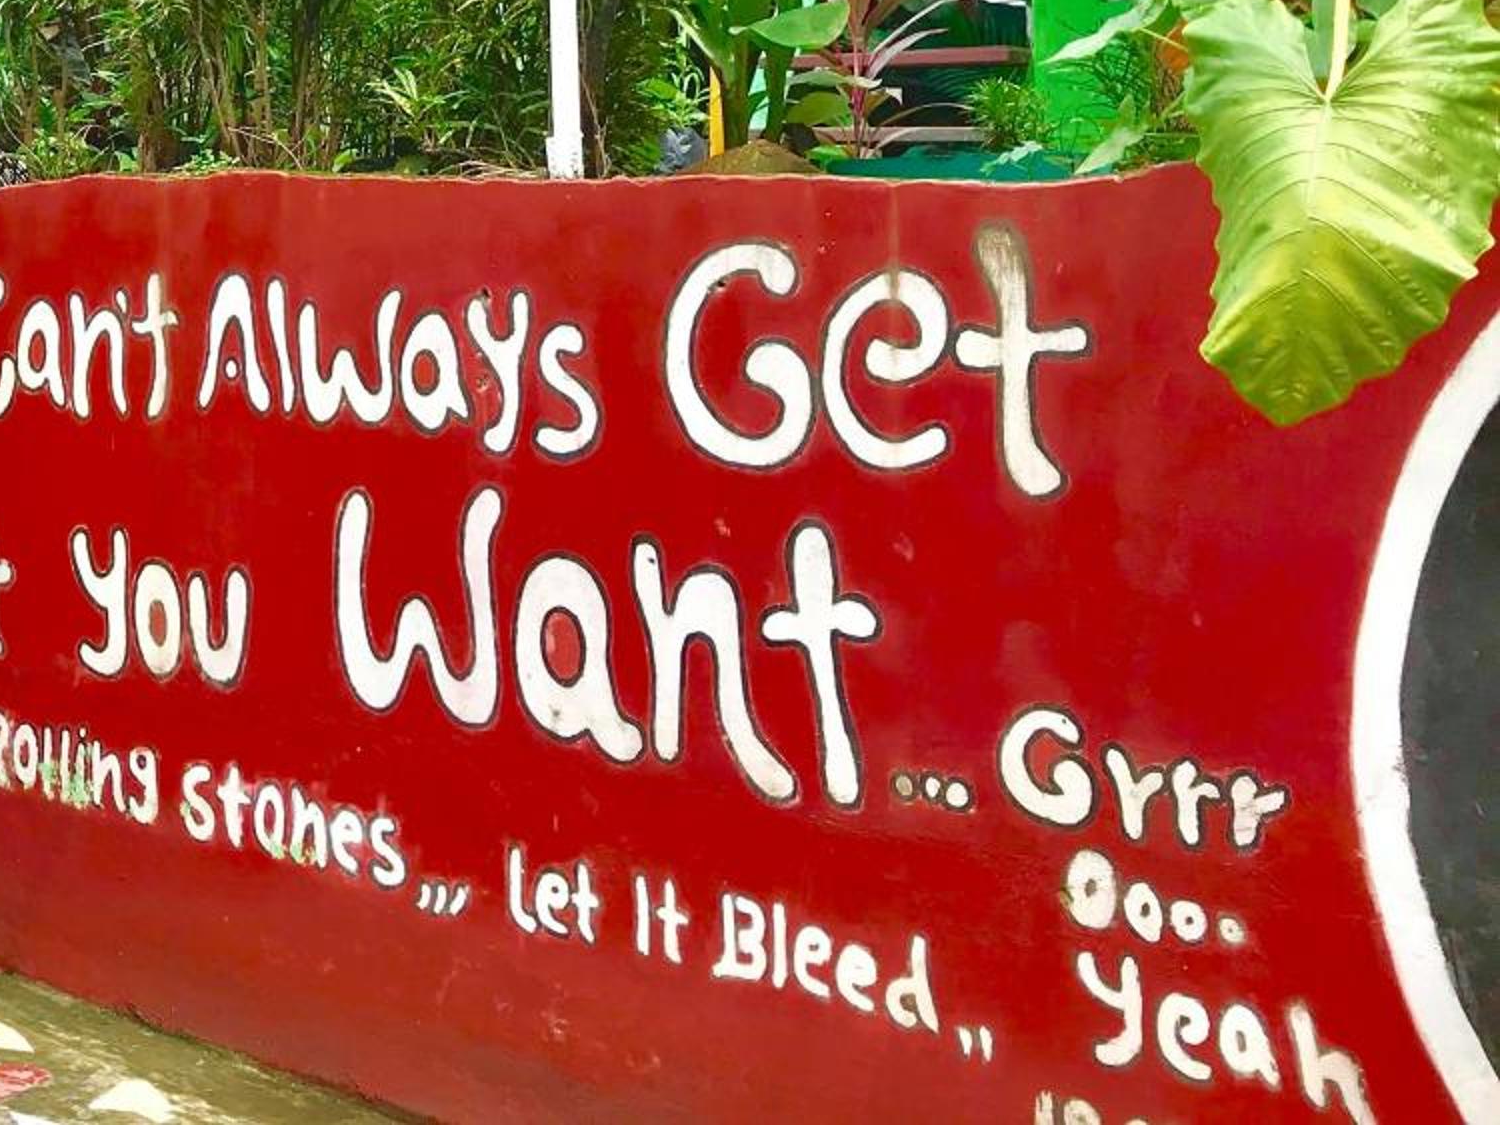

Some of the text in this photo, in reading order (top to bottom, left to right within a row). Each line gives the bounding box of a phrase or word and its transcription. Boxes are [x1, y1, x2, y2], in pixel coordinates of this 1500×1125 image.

[664, 225, 1088, 497] Get
[334, 487, 882, 807] Want
[1000, 707, 1286, 848] Grrr
